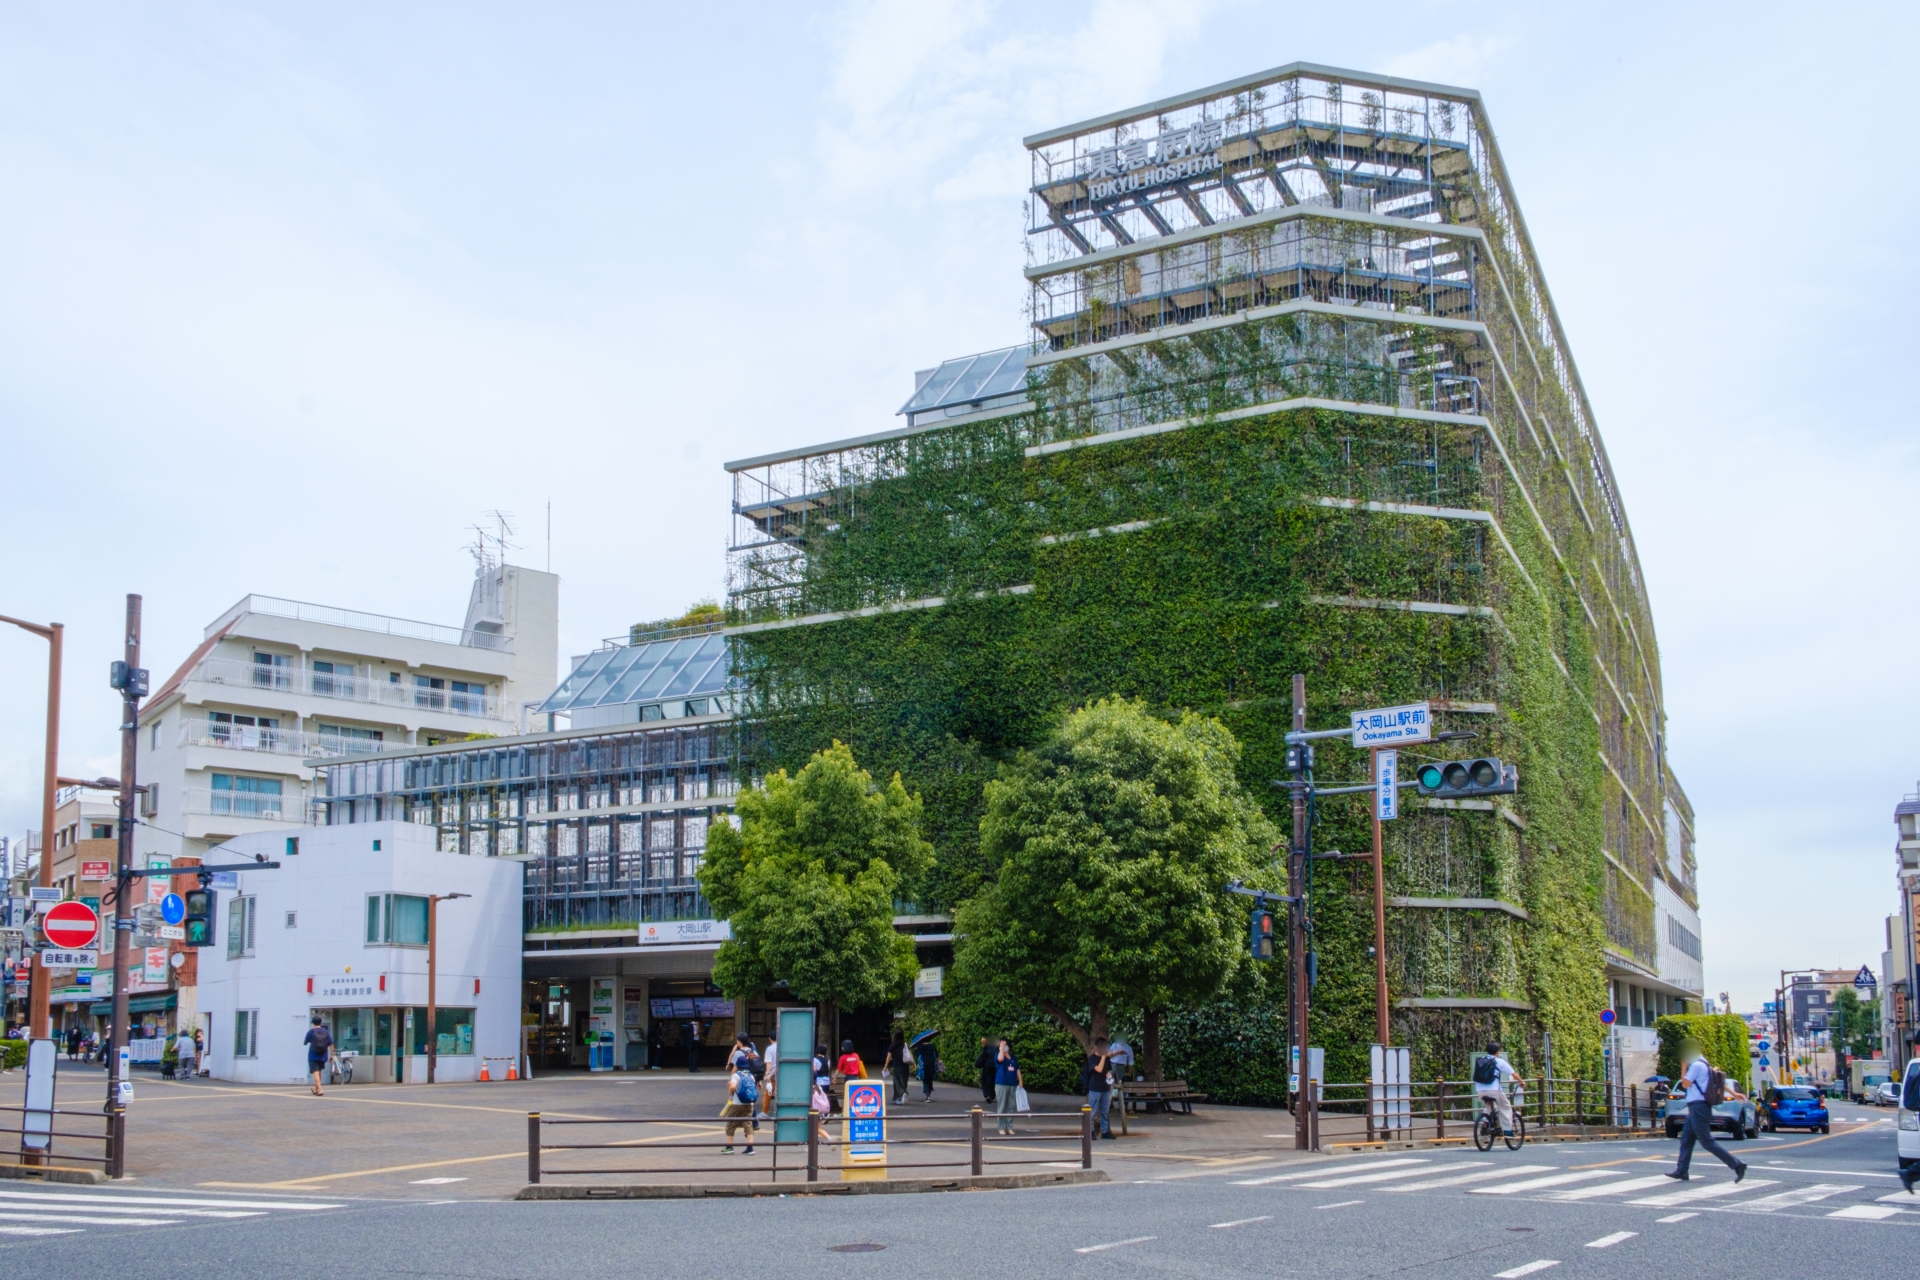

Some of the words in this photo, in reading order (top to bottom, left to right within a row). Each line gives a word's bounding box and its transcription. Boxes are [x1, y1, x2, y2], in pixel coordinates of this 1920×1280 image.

[1088, 118, 1223, 181] 東急病院
[1089, 172, 1139, 200] TOKYU
[1145, 152, 1223, 187] HOSPITAL
[1356, 709, 1426, 732] 大岡山駅前
[1362, 730, 1402, 741] Ookayama
[1405, 727, 1420, 736] Sta.
[677, 922, 711, 934] 大岡山駅
[45, 953, 94, 964] 自転車を除く
[323, 987, 372, 996] 大岡山駅前交番
